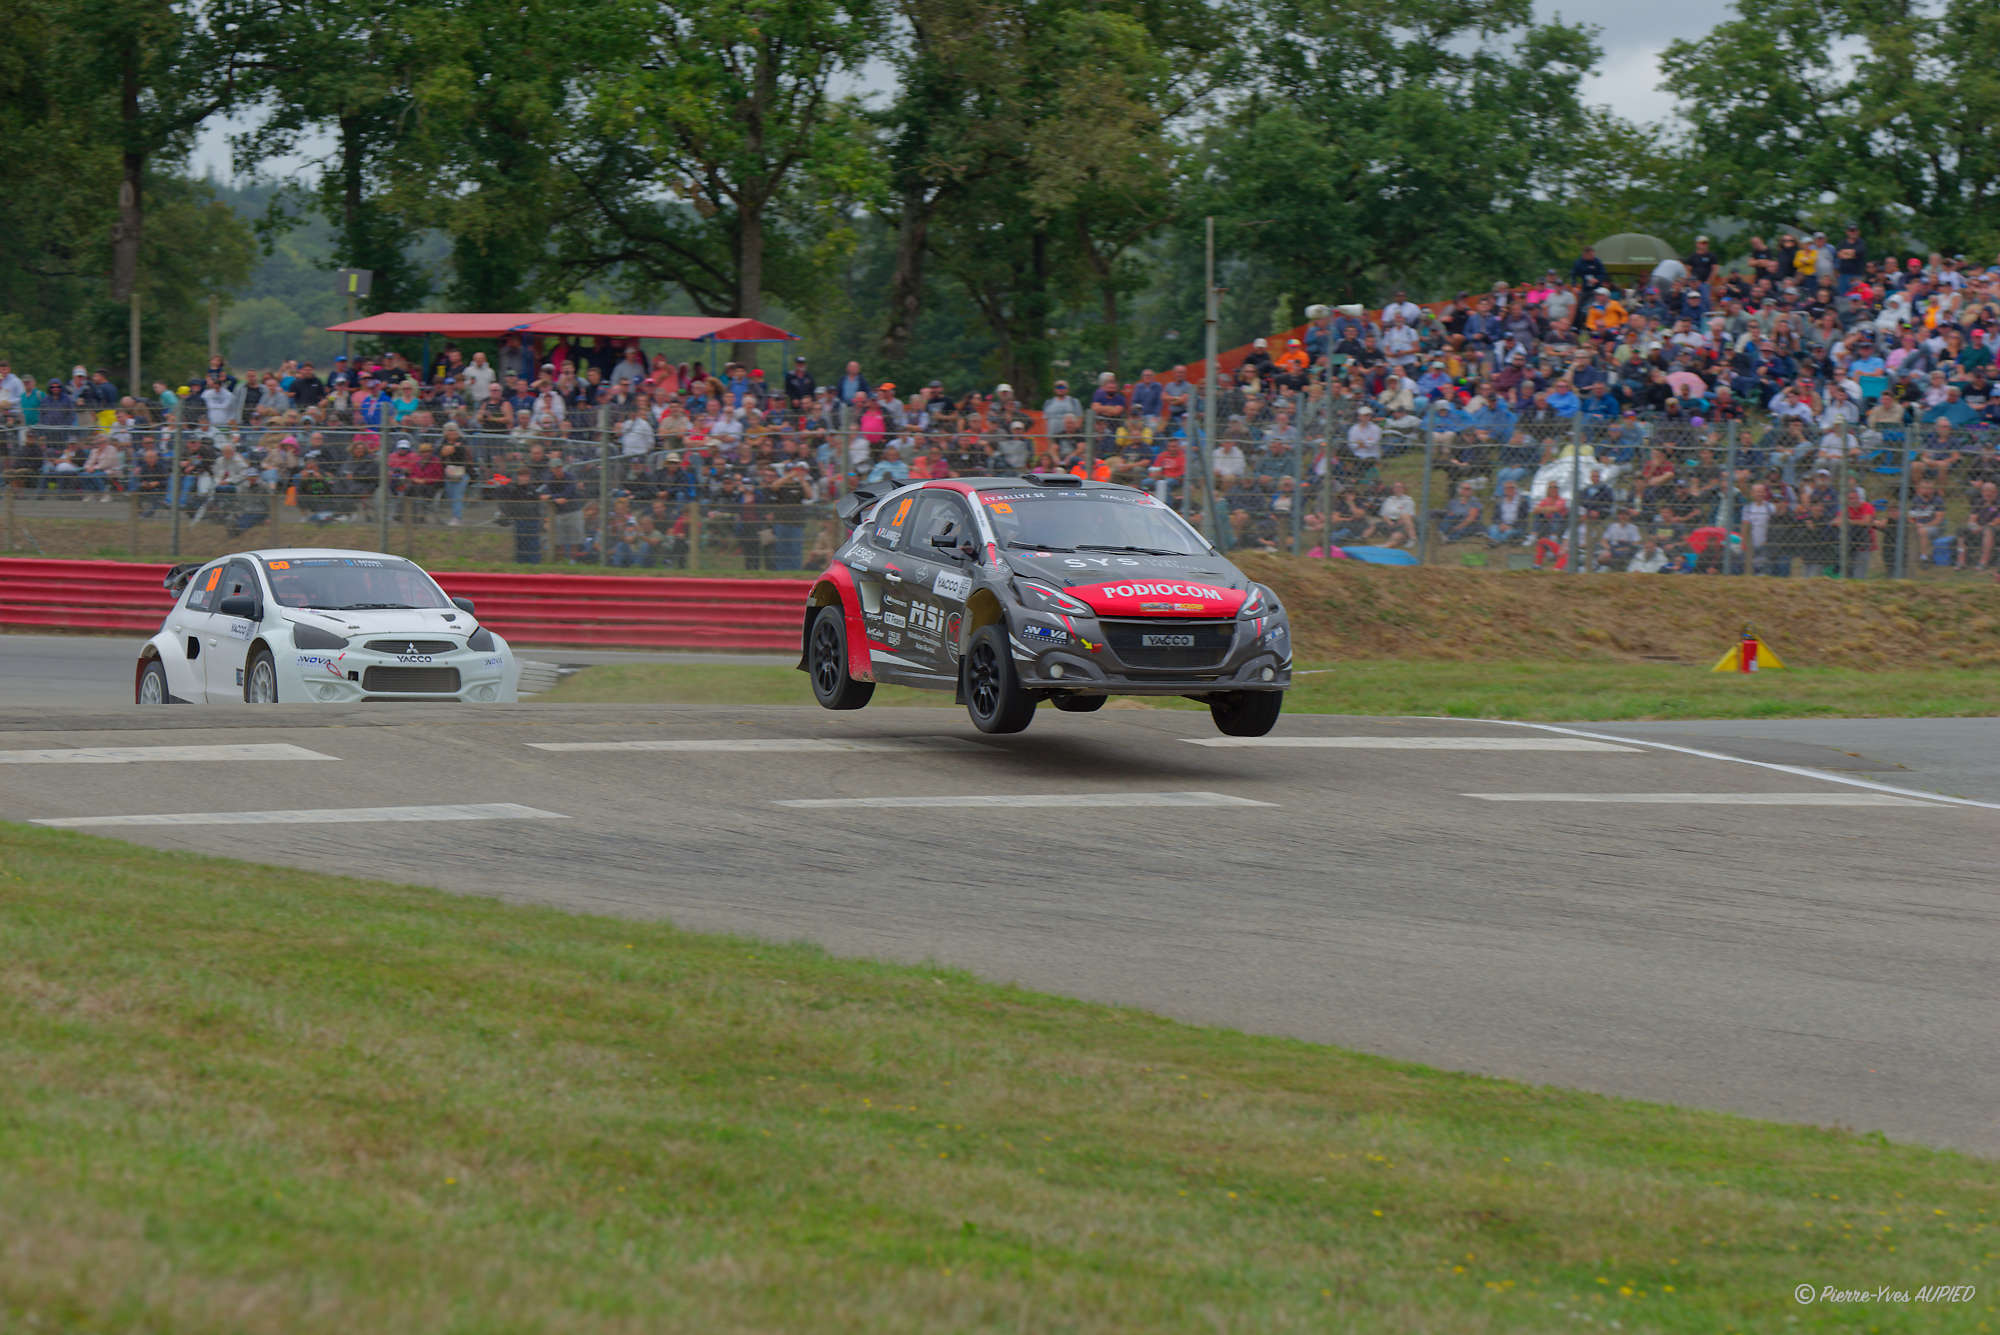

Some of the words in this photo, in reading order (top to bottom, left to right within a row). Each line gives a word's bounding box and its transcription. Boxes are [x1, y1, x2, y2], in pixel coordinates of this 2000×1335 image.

[891, 498, 912, 526] 19
[989, 503, 1014, 515] 19
[268, 560, 290, 570] 60
[1063, 557, 1140, 568] SYS
[937, 576, 959, 592] YACCO
[1102, 583, 1223, 601] PODIOCOM
[1148, 635, 1190, 646] YACCO
[396, 655, 432, 663] YACCO
